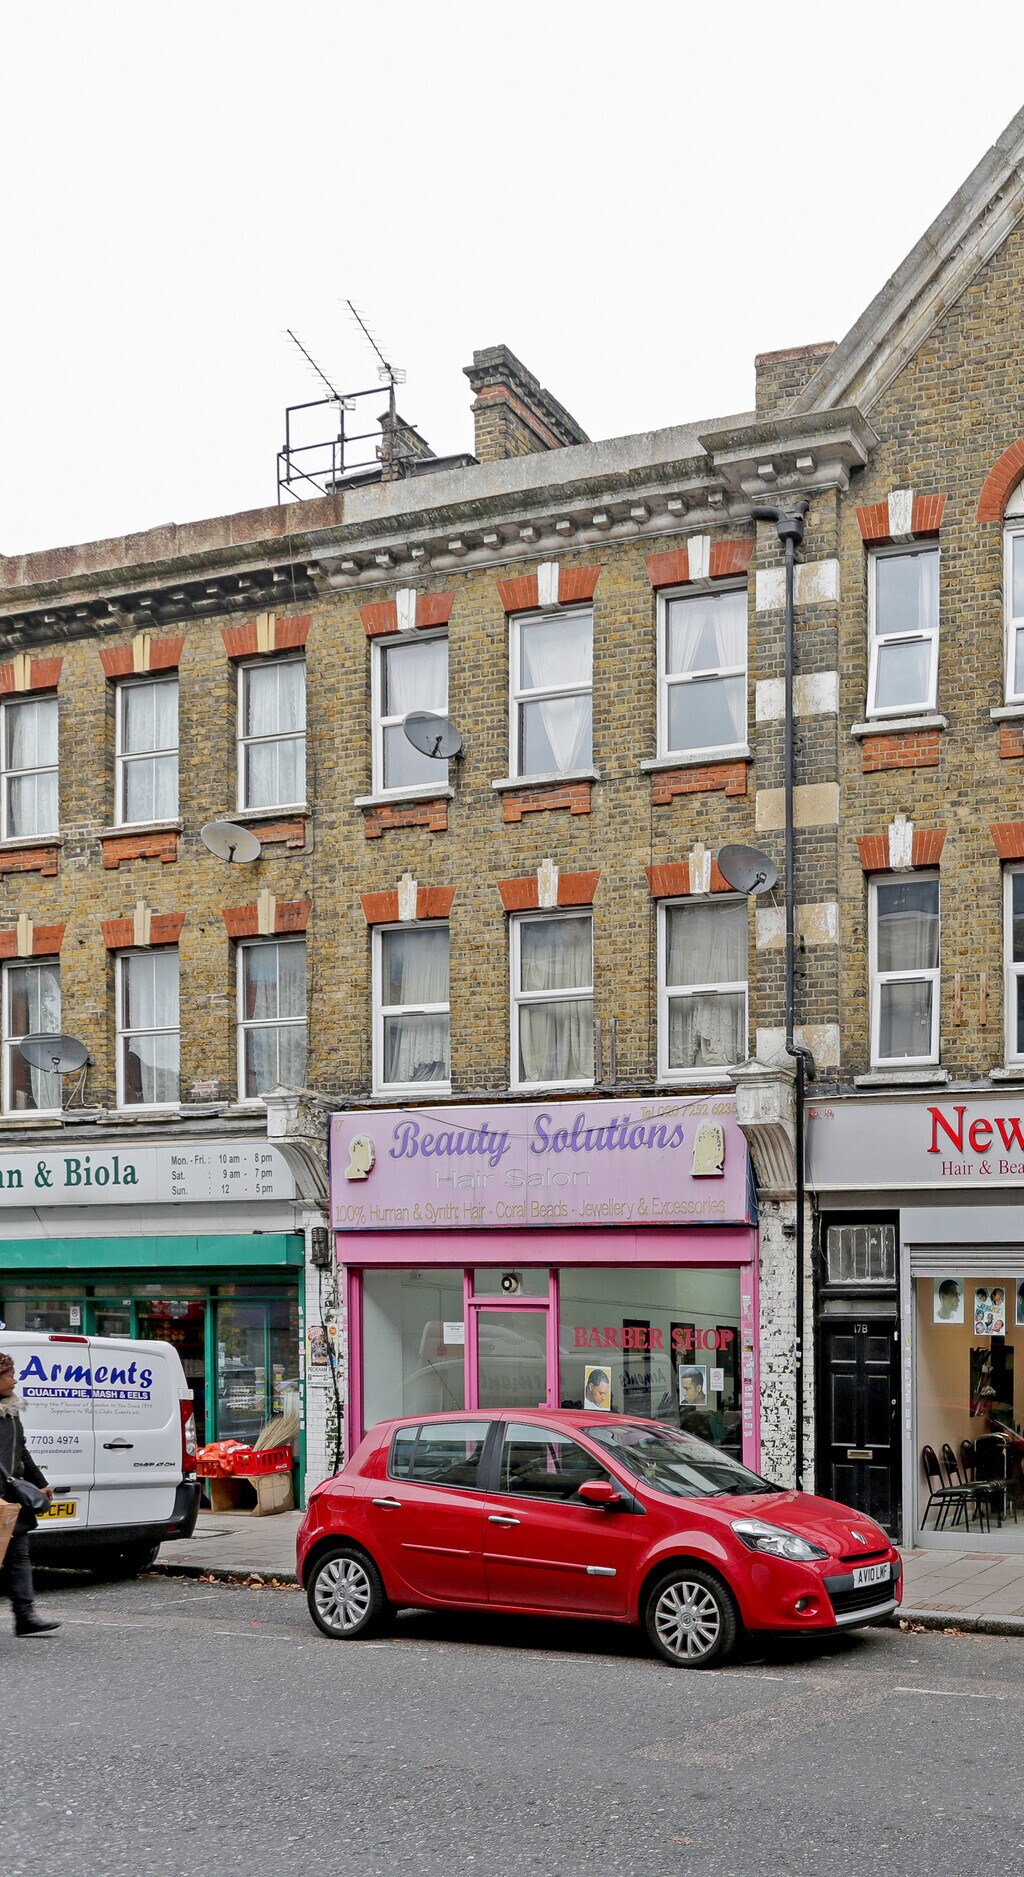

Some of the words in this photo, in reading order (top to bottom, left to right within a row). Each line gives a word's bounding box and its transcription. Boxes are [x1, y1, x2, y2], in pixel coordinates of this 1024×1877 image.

[389, 1119, 511, 1167] Beauty
[530, 1111, 685, 1154] Solutions
[219, 1154, 228, 1164] 10
[255, 1153, 260, 1163] 8
[261, 1155, 273, 1165] pm
[35, 1160, 54, 1188] &
[64, 1156, 139, 1187] Biola
[172, 1170, 186, 1180] Sat.
[223, 1169, 228, 1179] 9
[255, 1168, 259, 1178] 7
[261, 1171, 273, 1180] pm
[941, 1160, 974, 1176] Hair
[979, 1160, 993, 1175] &
[434, 1169, 496, 1190] Hair
[504, 1167, 592, 1189] Salon
[172, 1186, 188, 1195] Sun.
[221, 1185, 230, 1194] 12
[256, 1183, 260, 1193] 5
[261, 1185, 273, 1195] pm
[335, 1205, 367, 1225] 100%
[370, 1203, 409, 1221] Human
[413, 1203, 423, 1220] &
[464, 1202, 486, 1219] Hair
[496, 1201, 527, 1219] Coral
[531, 1200, 568, 1217] Beads
[579, 1198, 634, 1219] Jewellery
[638, 1198, 648, 1215] &
[653, 1197, 725, 1215] Excessories
[854, 1324, 868, 1334] 17B
[573, 1327, 664, 1349] BARBER
[671, 1328, 734, 1350] SHOP
[19, 1355, 153, 1389] Arments
[27, 1388, 70, 1397] QUALITY
[71, 1389, 90, 1399] PIE,
[93, 1390, 118, 1399] MASH
[120, 1391, 126, 1399] &
[127, 1391, 149, 1399] EELS
[30, 1436, 54, 1445] 7703
[57, 1436, 79, 1445] 4974
